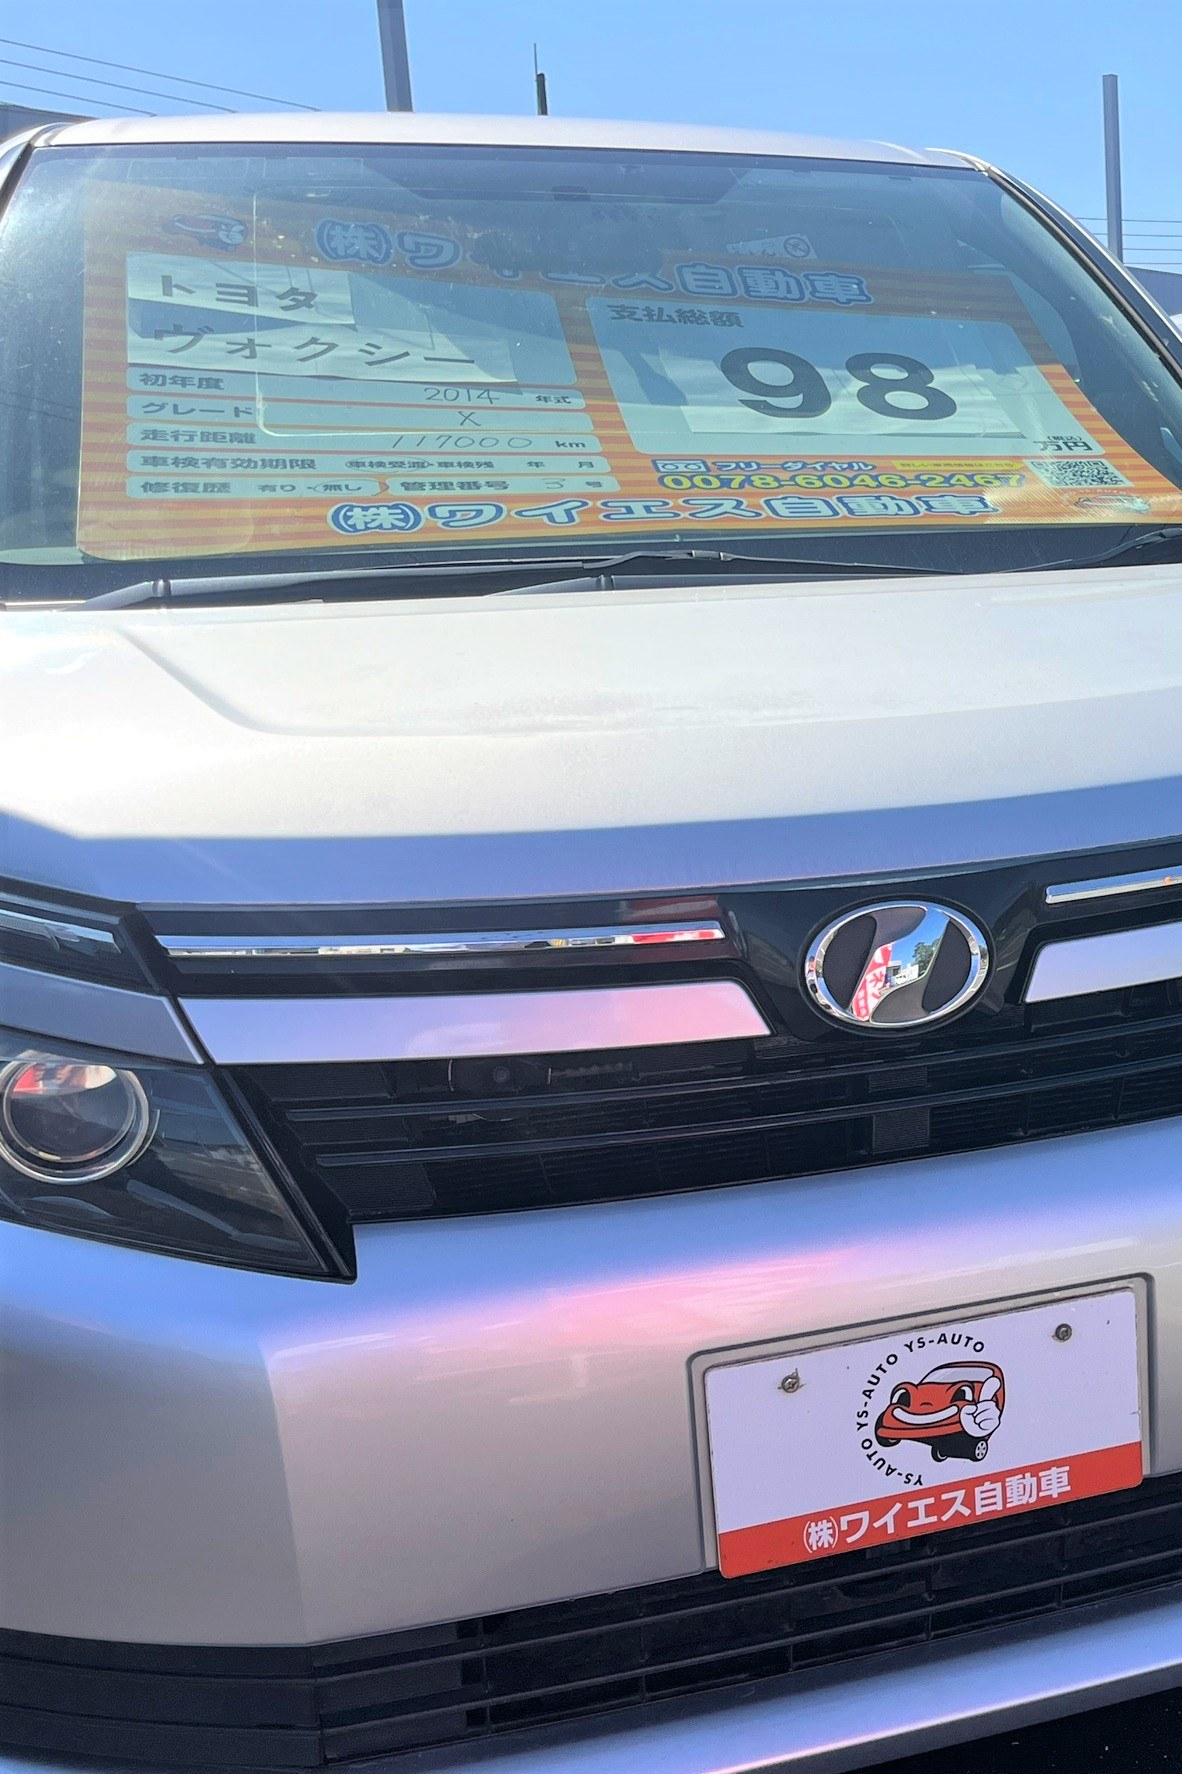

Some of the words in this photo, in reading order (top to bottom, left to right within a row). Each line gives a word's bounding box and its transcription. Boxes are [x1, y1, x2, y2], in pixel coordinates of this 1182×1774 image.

[315, 218, 873, 304] (株)ワ自動車
[161, 274, 319, 311] トヨタ
[606, 303, 744, 327] 支払総額
[154, 323, 475, 366] ヴォクシー
[139, 372, 225, 391] 初年度
[424, 387, 500, 405] 2014
[535, 394, 572, 404] 年式
[720, 346, 958, 421] 98
[141, 402, 253, 418] グレード
[457, 410, 482, 427] X
[140, 428, 257, 444] 走行距離
[554, 440, 587, 449] km
[140, 455, 317, 470] 車検有効期限
[711, 460, 877, 473] フリーダイヤル
[141, 481, 232, 494] 修復歴
[400, 481, 511, 491] 管理番号
[658, 473, 1027, 491] 0078-6046-2467
[331, 494, 1003, 535] (株)ワイエス自動車
[904, 1333, 985, 1353] YS-AUTO
[856, 1353, 898, 1431] YS-AUTO
[861, 1438, 924, 1486] YS-AUTO
[802, 1465, 1071, 1554] (株)ワイエス自動車
